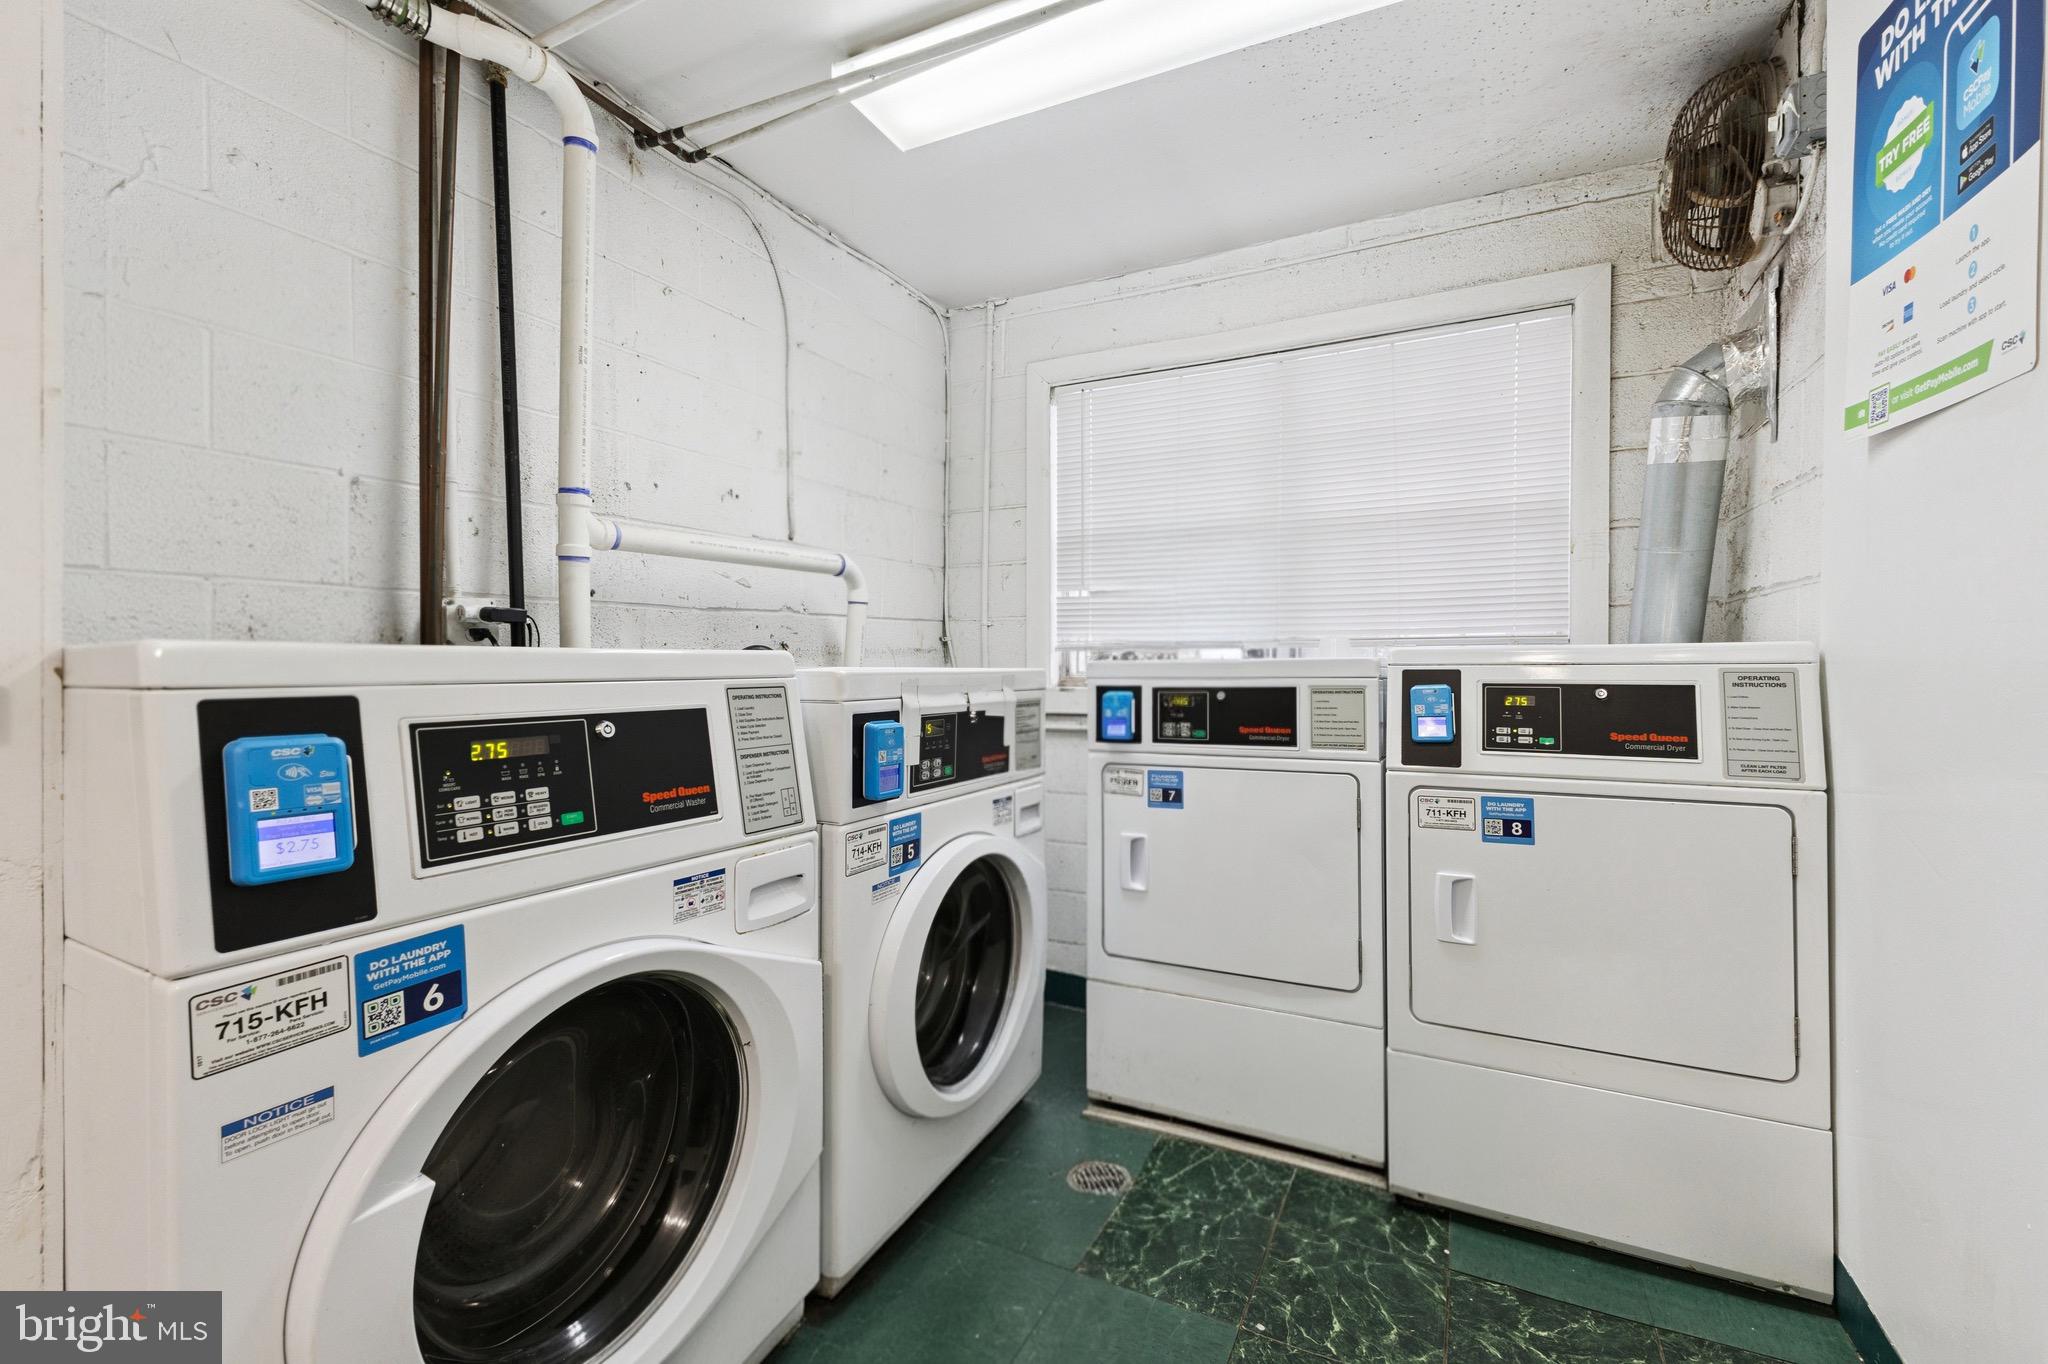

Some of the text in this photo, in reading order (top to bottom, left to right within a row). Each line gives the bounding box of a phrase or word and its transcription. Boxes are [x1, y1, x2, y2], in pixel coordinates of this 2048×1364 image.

[1881, 7, 1909, 58] DO
[1874, 14, 1926, 90] WITH
[1879, 143, 1900, 173] TRY
[1902, 115, 1931, 153] FREE
[1882, 281, 1896, 296] VISA
[2001, 335, 2018, 351] CSC
[1891, 358, 1979, 404] or visit GetPayMobile.com
[1238, 726, 1291, 735] Speed Queen
[1610, 732, 1688, 743] Speed Queen
[271, 748, 301, 758] CSC
[471, 742, 509, 761] 2.75
[763, 749, 789, 757] INSTRUCTIONS
[1625, 743, 1686, 752] Commercial Dryer
[642, 784, 710, 803] Speed Queen
[1168, 790, 1176, 801] 7
[650, 797, 706, 814] Commercial Washer
[1426, 809, 1466, 818] 711-KFH
[900, 820, 917, 830] LAUNDRY
[1512, 822, 1522, 835] 8
[276, 838, 320, 855] $2.75
[852, 841, 882, 858] 714-KFH
[908, 844, 914, 859] 5
[691, 873, 710, 882] NOTICE
[370, 940, 447, 971] DO LAUNDRY
[366, 949, 451, 982] WITH THE APP
[373, 963, 446, 990] GetPayMobile.com
[195, 991, 239, 1012] CSC
[423, 983, 444, 1012] 6
[215, 991, 328, 1040] 715-KFH
[227, 1035, 237, 1043] For
[289, 1015, 301, 1023] Para
[246, 1021, 305, 1045] 1-877-264-6622
[211, 1056, 223, 1065] Visit
[234, 1046, 254, 1057] website
[243, 1095, 315, 1128] NOTICE
[224, 1130, 246, 1144] DOOR
[248, 1122, 267, 1135] LOCK
[269, 1114, 290, 1127] LIGHT
[291, 1109, 306, 1118] must
[224, 1138, 244, 1150] before
[247, 1125, 280, 1142] attempting
[289, 1116, 304, 1126] open
[254, 1135, 270, 1146] push
[272, 1129, 285, 1139] door
[295, 1121, 307, 1129] then
